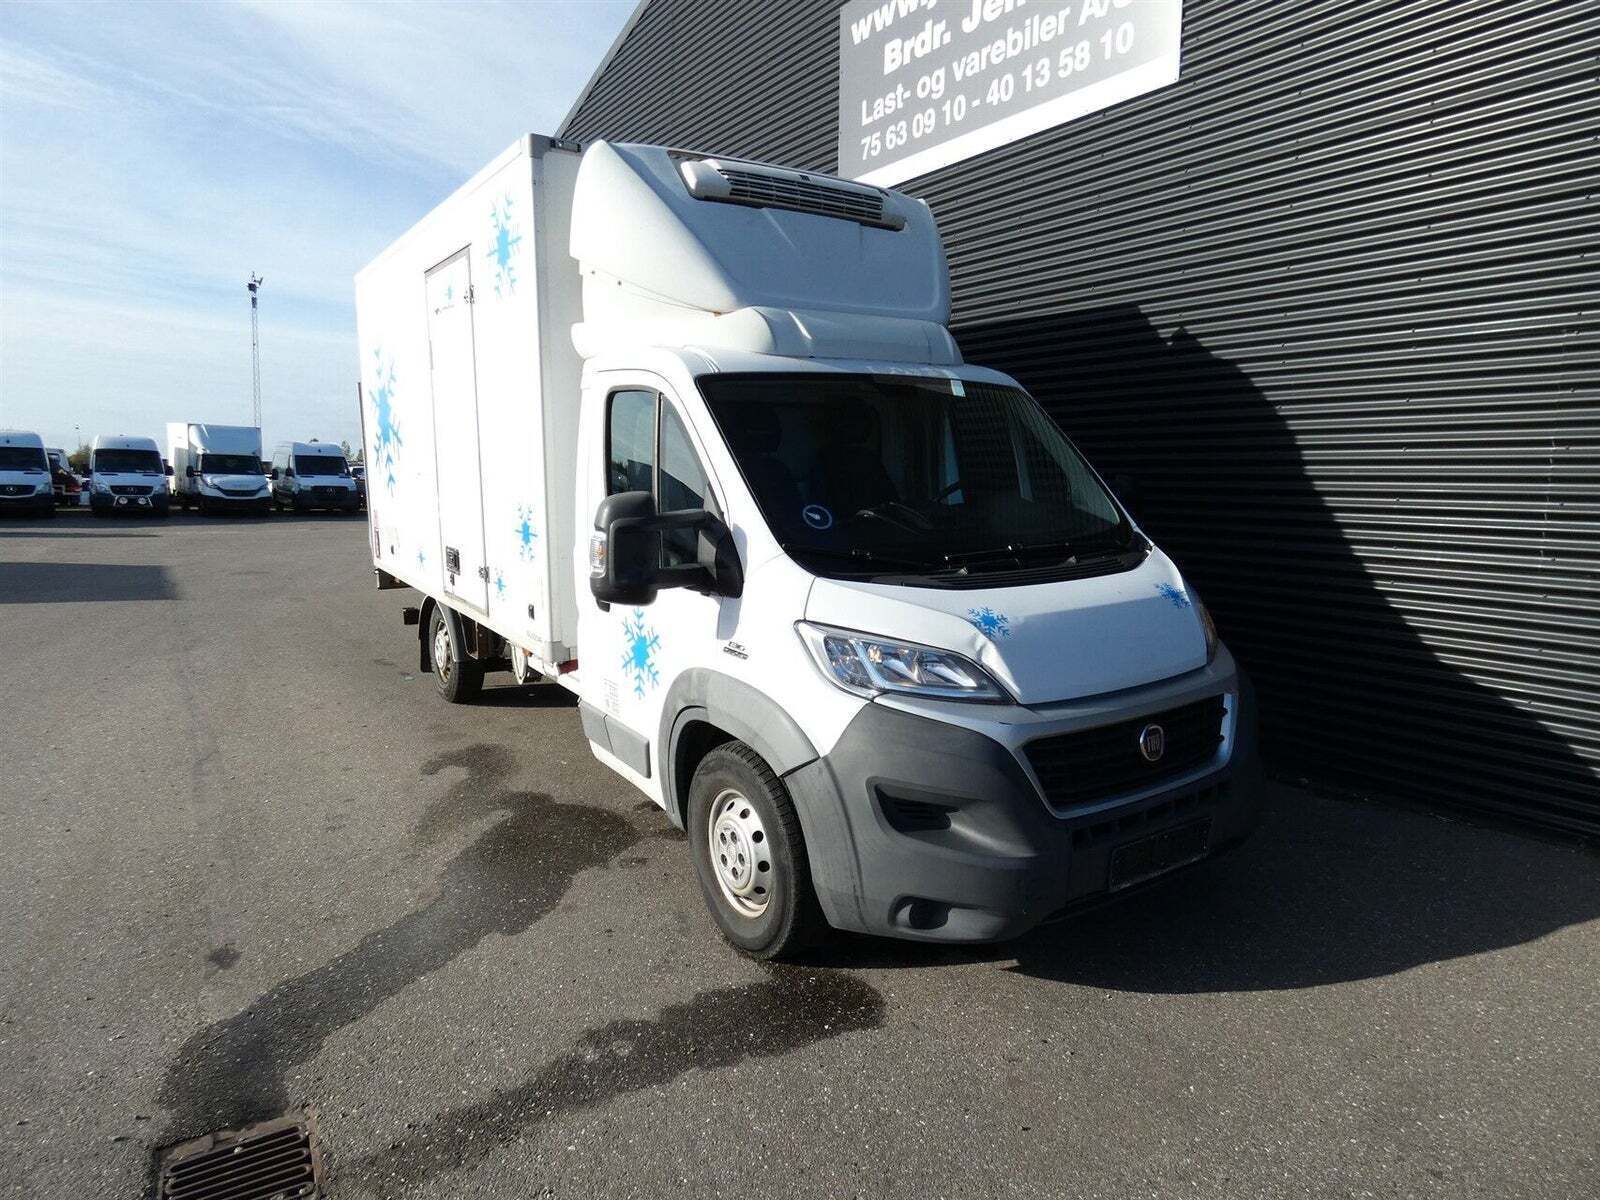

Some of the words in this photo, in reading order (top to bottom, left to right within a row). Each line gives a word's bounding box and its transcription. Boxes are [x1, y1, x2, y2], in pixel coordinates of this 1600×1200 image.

[860, 131, 881, 160] 75
[885, 120, 907, 150] 63
[912, 107, 936, 138] 09
[942, 94, 966, 126] 10
[985, 73, 1015, 106] 40
[1022, 57, 1051, 92] 13
[1058, 40, 1090, 78] 58
[1100, 21, 1135, 60] 10
[861, 83, 911, 126] Last-
[916, 66, 945, 99] og
[952, 6, 1071, 82] varebiler
[883, 19, 951, 76] Brdr.
